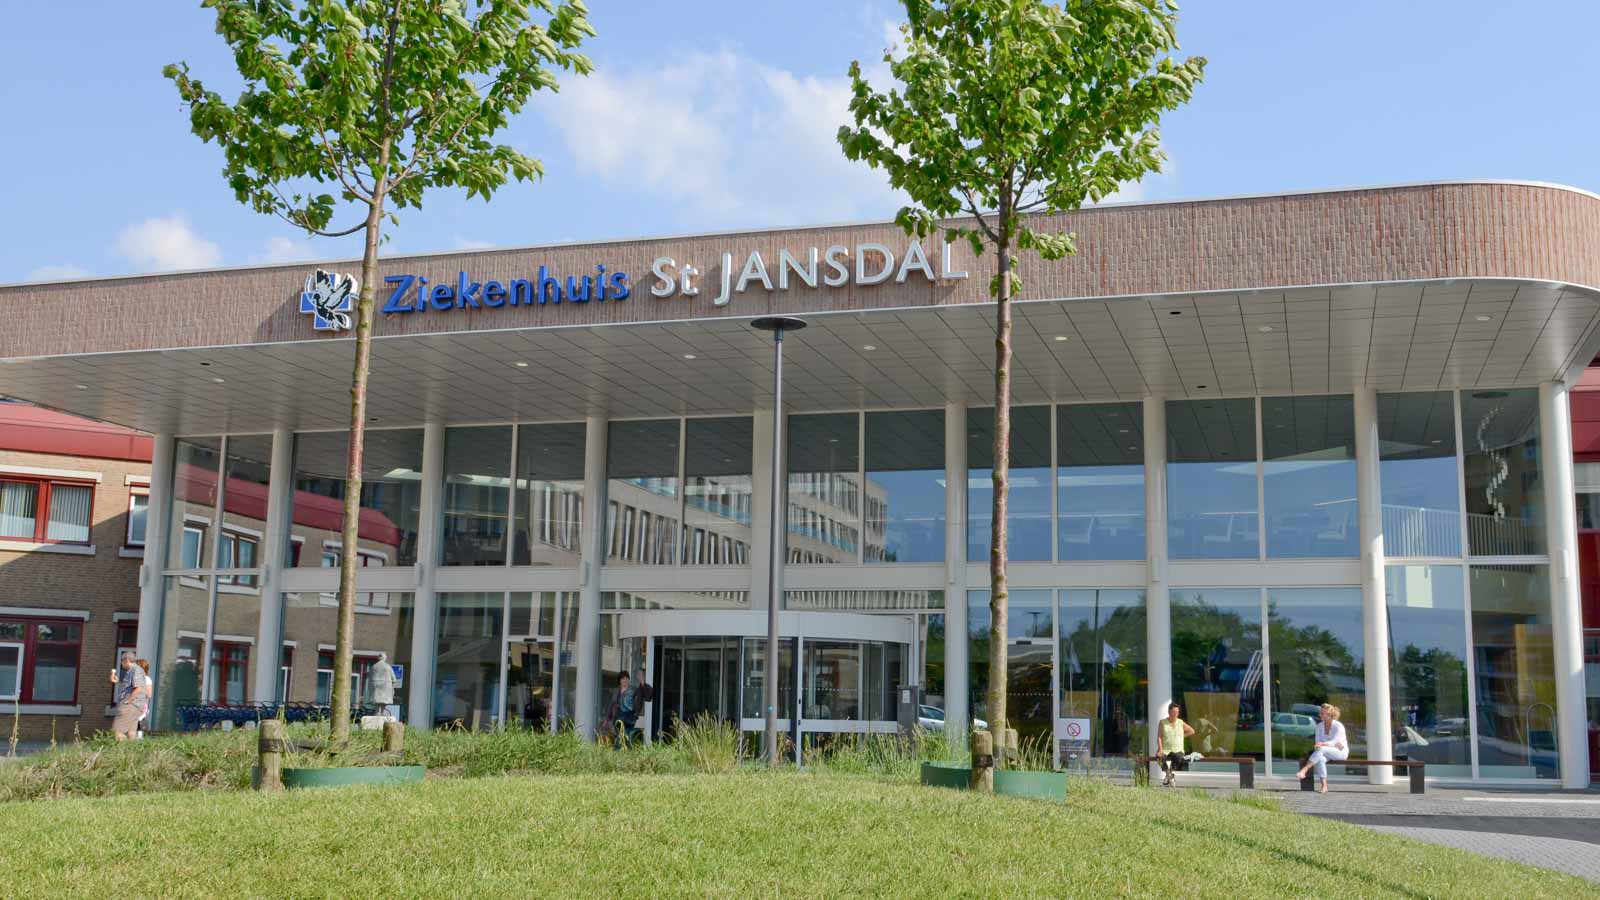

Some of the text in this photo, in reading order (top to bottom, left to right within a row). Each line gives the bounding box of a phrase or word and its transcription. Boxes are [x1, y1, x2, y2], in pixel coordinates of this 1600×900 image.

[383, 239, 968, 313] Ziekenhuis St JANSDAL
